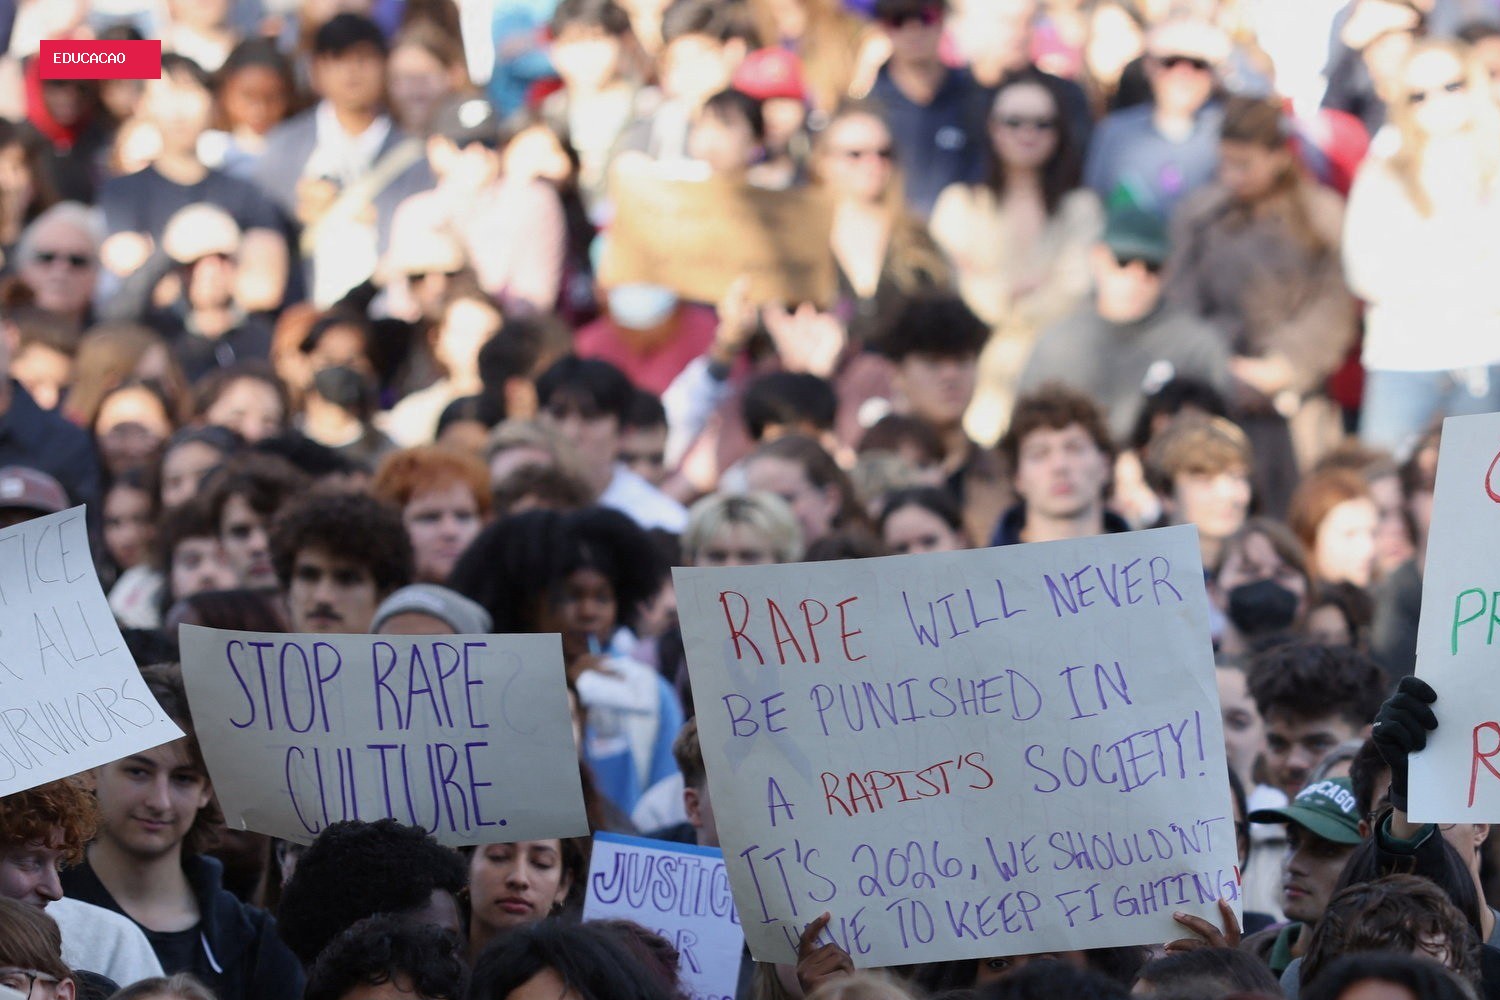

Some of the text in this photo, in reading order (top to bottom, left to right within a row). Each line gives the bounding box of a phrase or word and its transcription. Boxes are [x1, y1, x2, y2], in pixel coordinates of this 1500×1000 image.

[33, 600, 119, 676] ALL
[719, 556, 1184, 665] RAPE WILL NEVER
[226, 639, 490, 733] STOP RAPE
[723, 661, 1132, 737] BE PUNISHED IN
[767, 711, 1206, 827] A RAPIST'S SOCIETY!
[1295, 781, 1356, 813] CAGO
[592, 852, 741, 925] JUSTIC
[740, 816, 1226, 923] IT'S 2026, WE SHOULDN'T
[886, 897, 935, 949] TO
[945, 890, 1041, 940] KEEP
[1055, 865, 1242, 928] FIGHTING!
